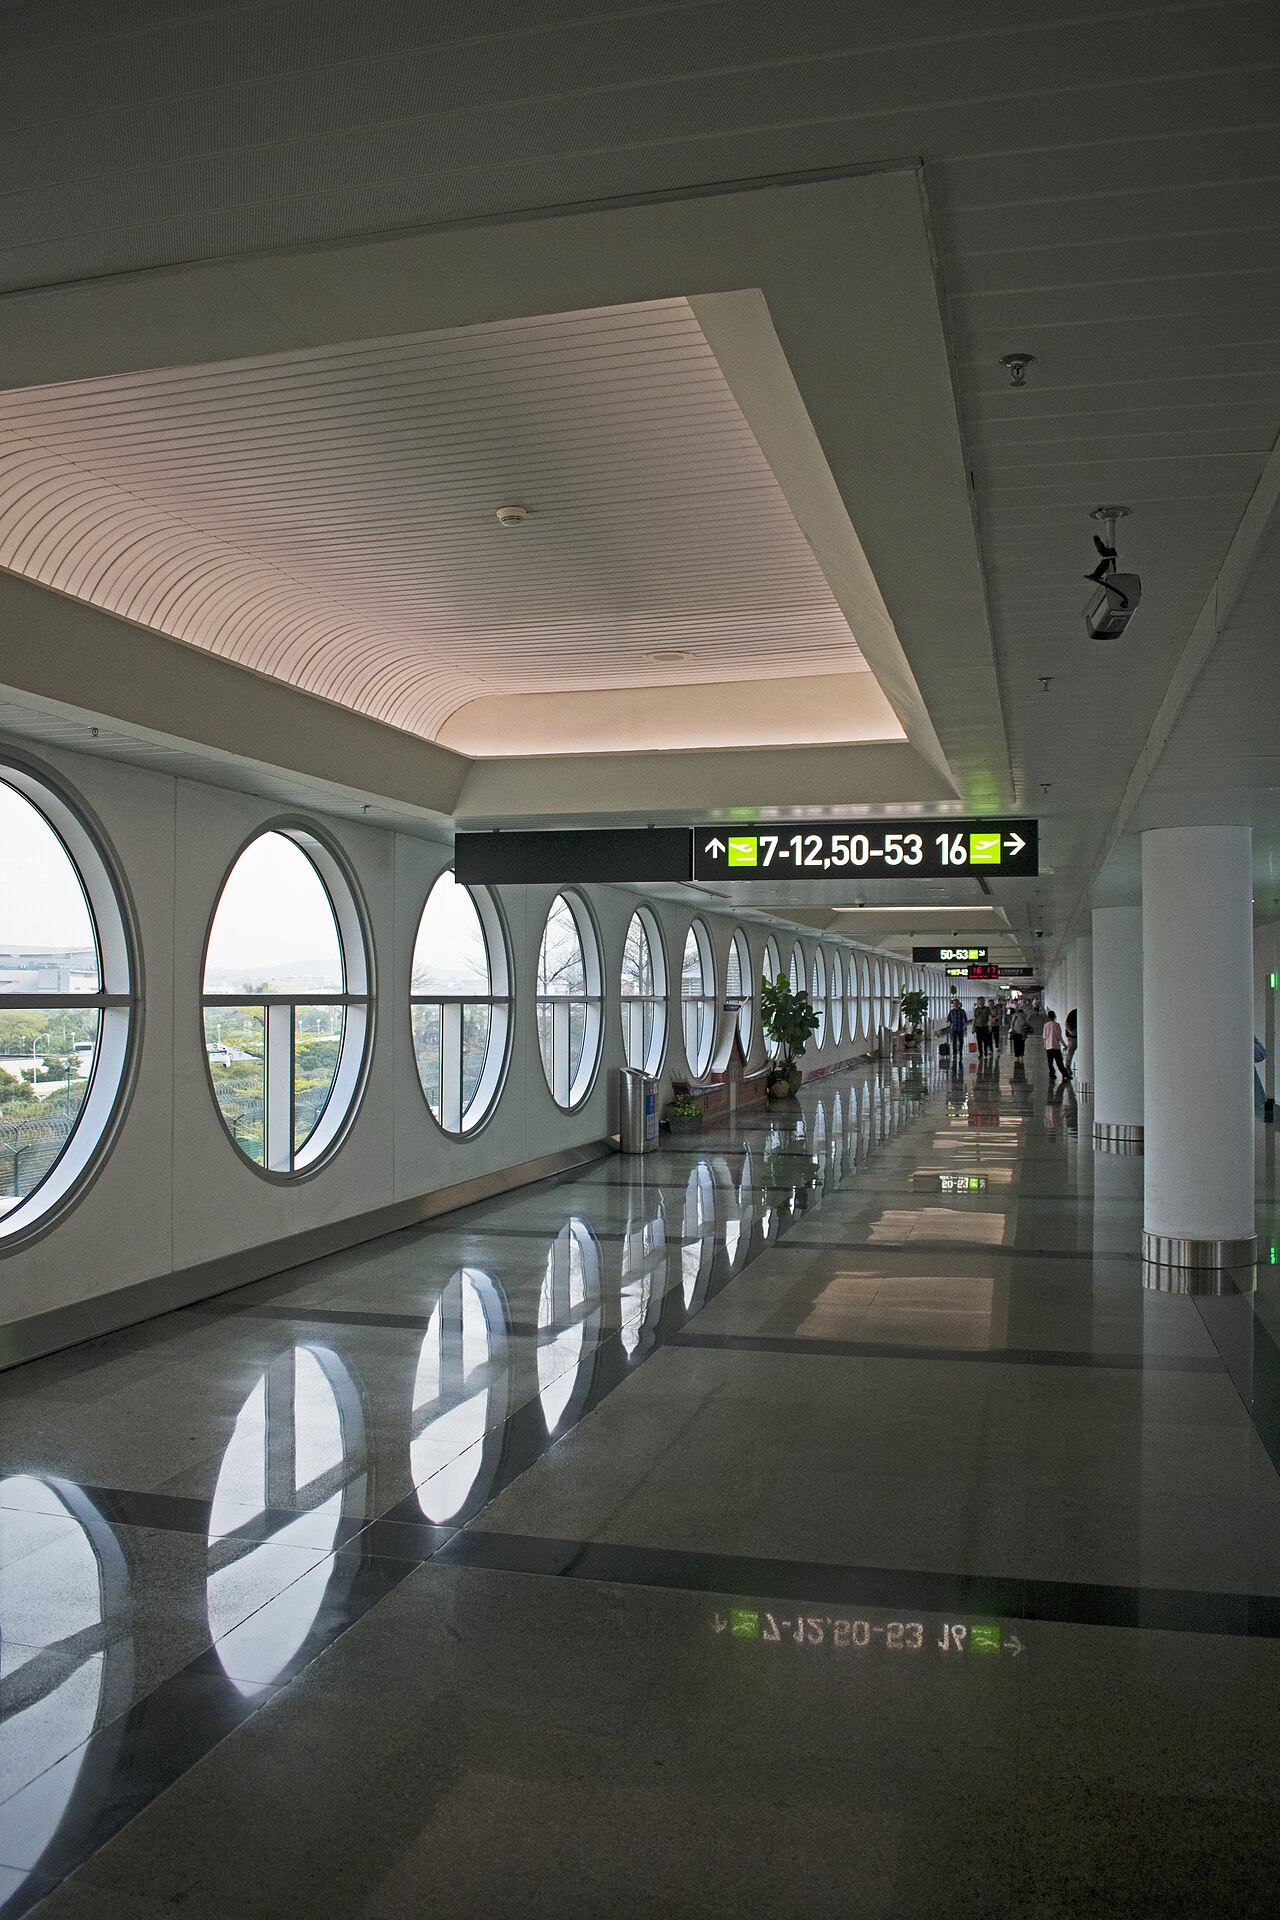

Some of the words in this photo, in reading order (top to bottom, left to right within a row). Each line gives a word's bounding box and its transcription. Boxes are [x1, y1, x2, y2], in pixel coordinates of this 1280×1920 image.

[759, 833, 923, 870] 7-12,50-53
[936, 833, 967, 866] 16
[940, 949, 968, 959] 50-53
